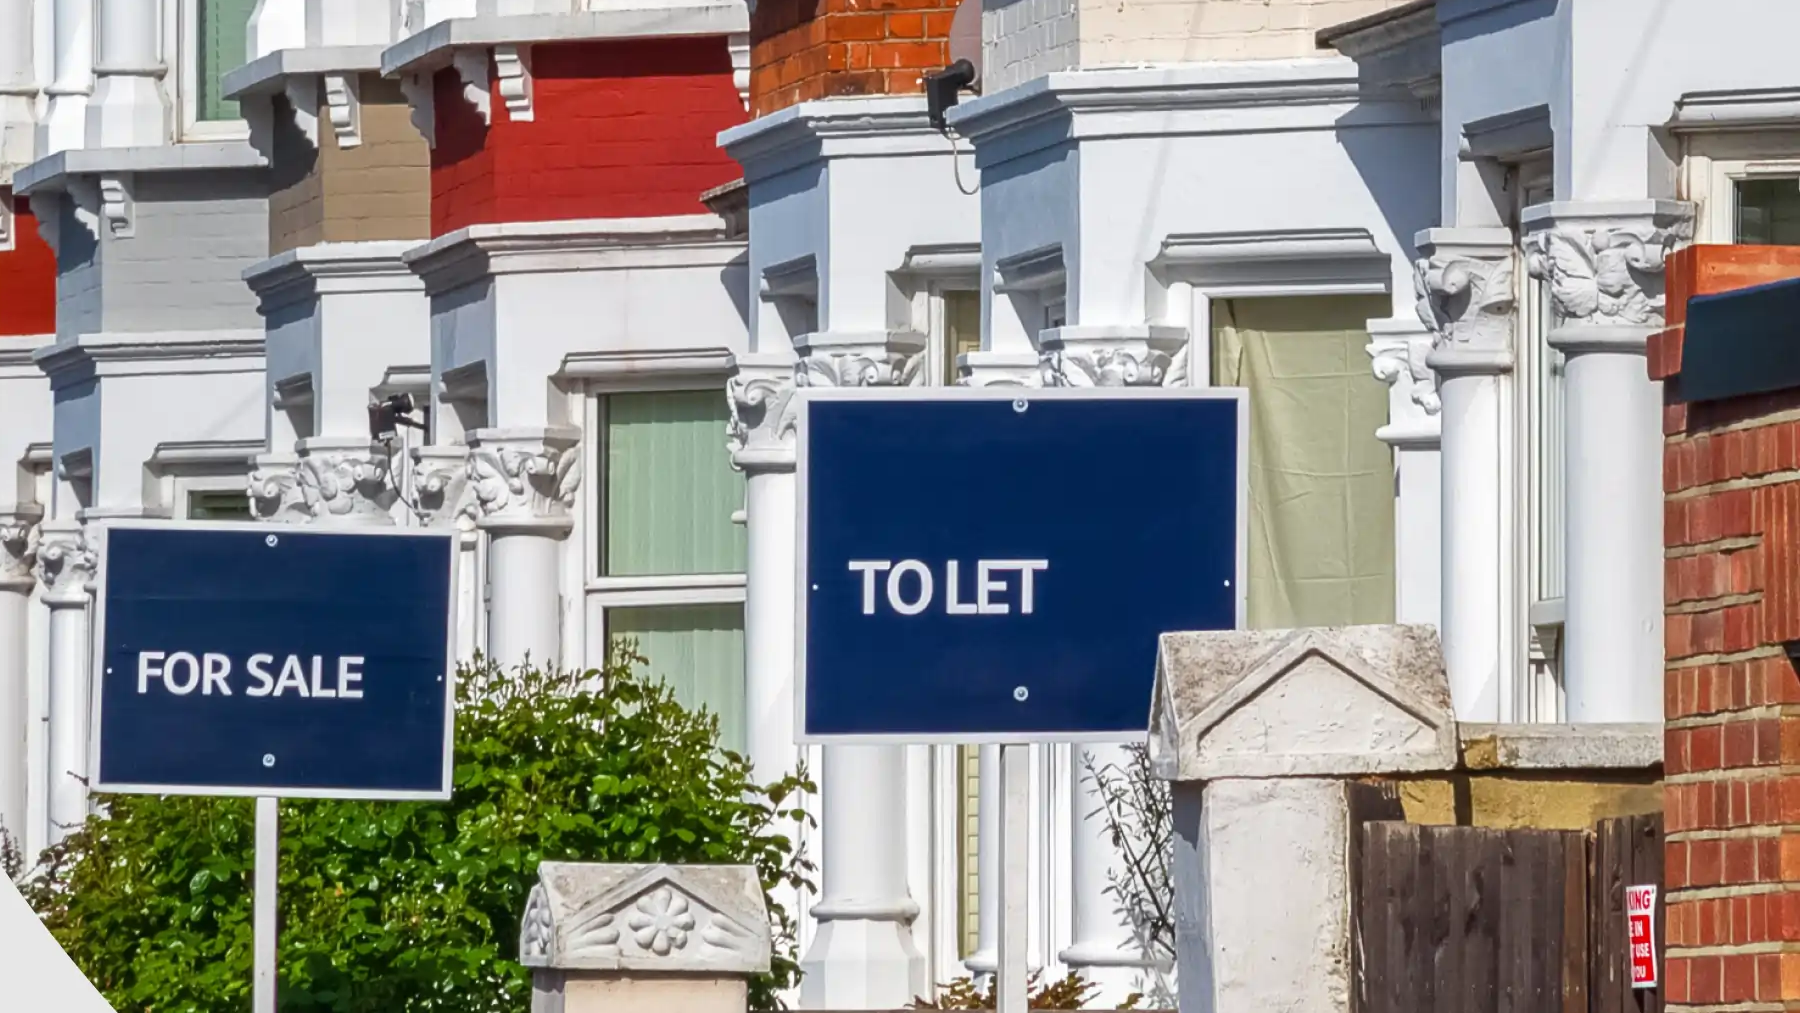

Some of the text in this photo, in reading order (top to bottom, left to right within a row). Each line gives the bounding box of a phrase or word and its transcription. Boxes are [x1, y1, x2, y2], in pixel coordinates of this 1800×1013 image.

[848, 559, 1049, 615] TO LET
[137, 651, 365, 699] FOR SALE
[1635, 943, 1650, 958] USE
